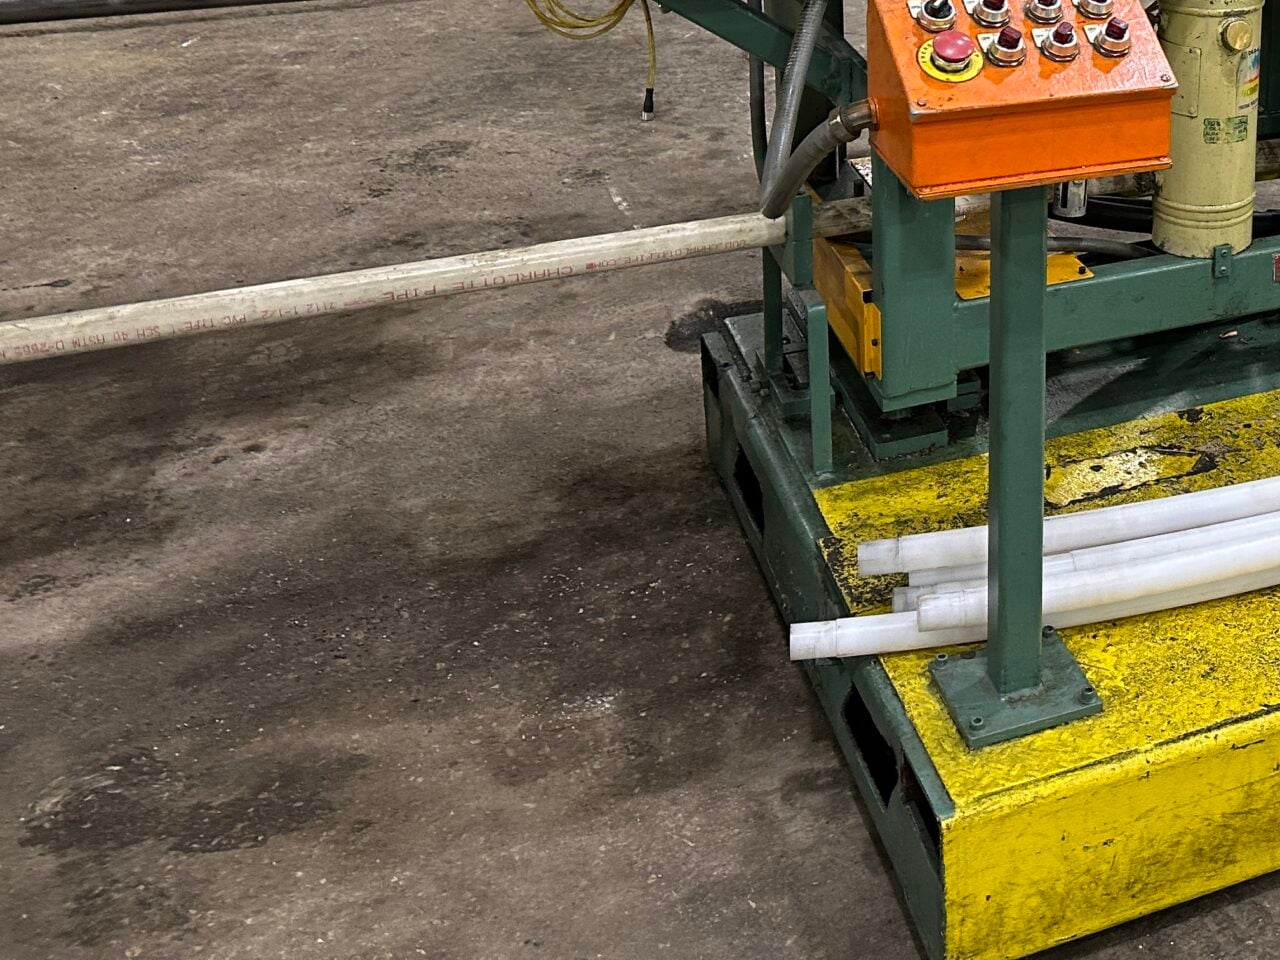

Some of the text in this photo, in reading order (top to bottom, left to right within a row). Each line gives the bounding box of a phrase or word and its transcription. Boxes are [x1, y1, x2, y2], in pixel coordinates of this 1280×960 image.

[453, 266, 574, 291] CHARLOTTE
[382, 285, 438, 301] PIPE
[223, 314, 248, 327] PVC
[137, 325, 161, 339] SCH
[72, 334, 105, 347] ASTM
